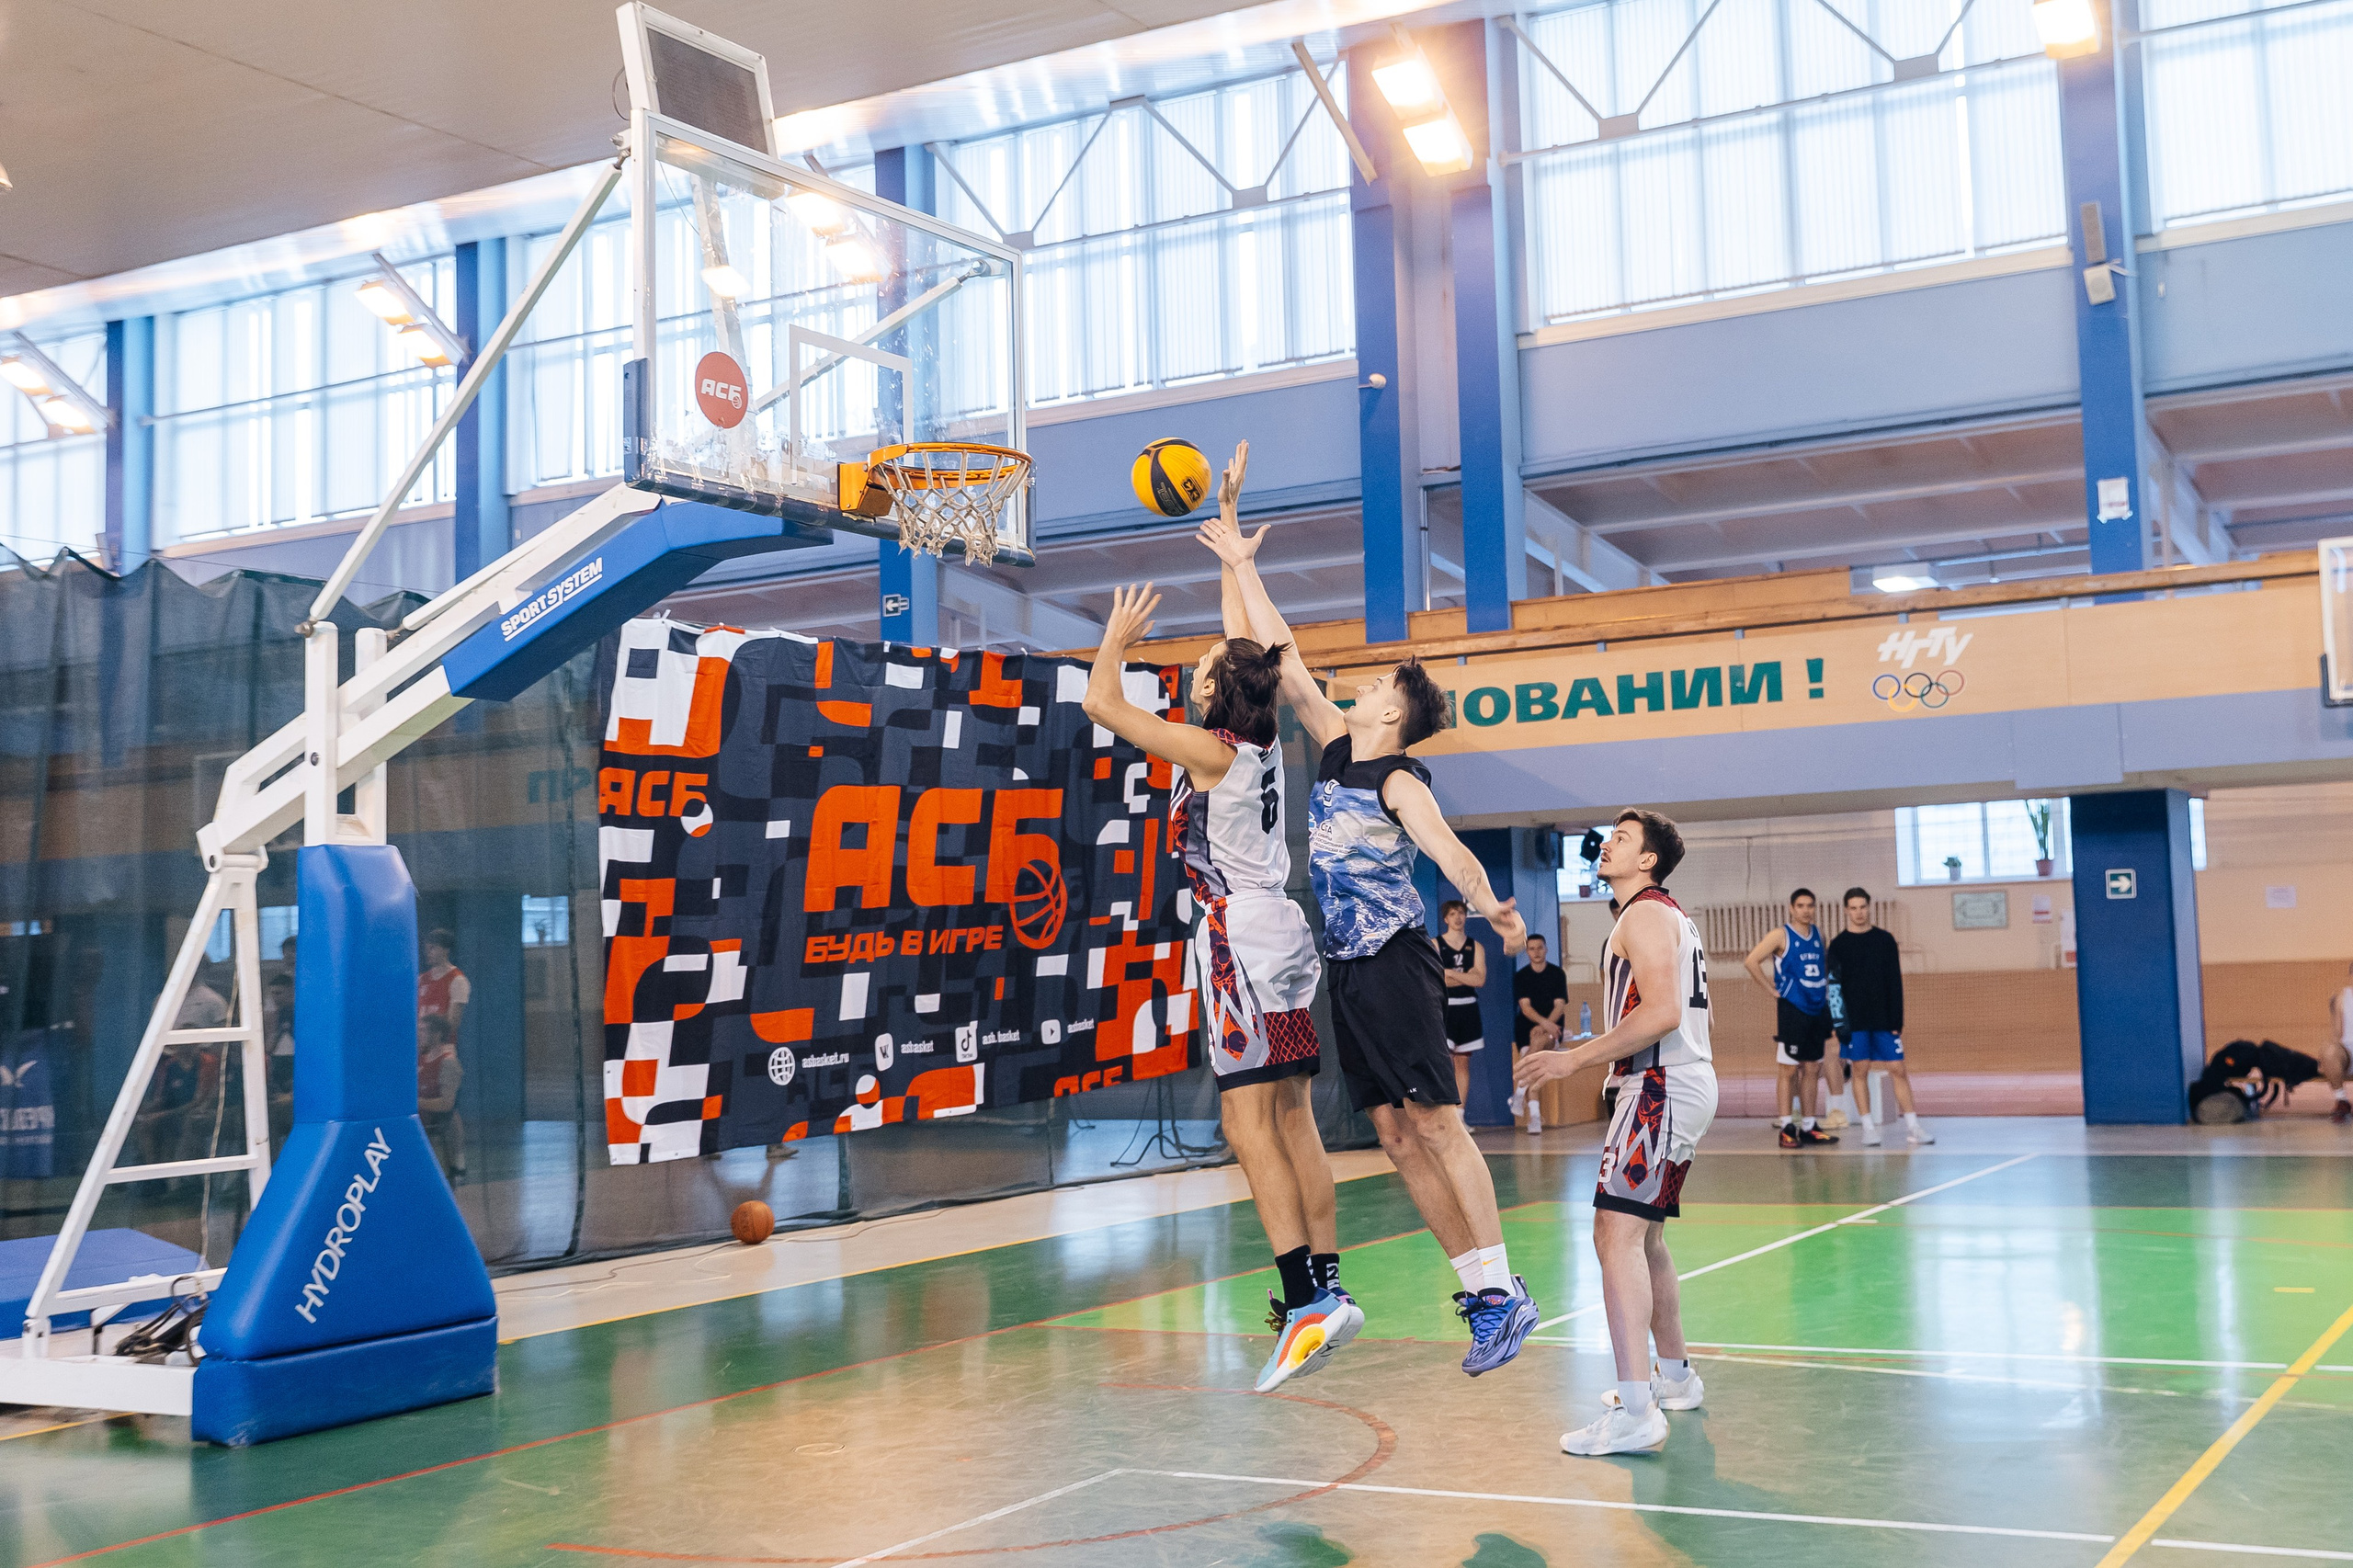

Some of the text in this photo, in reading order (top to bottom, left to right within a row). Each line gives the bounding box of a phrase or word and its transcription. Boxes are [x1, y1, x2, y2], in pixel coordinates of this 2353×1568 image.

[701, 378, 742, 405] АСБ
[1445, 661, 1782, 730] ОВАНИИ
[598, 767, 709, 817] АСБ
[803, 785, 1065, 915] АСБ
[804, 925, 1005, 963] БУДЬ В ИГРЕ
[295, 1127, 392, 1324] HYDROPLAY
